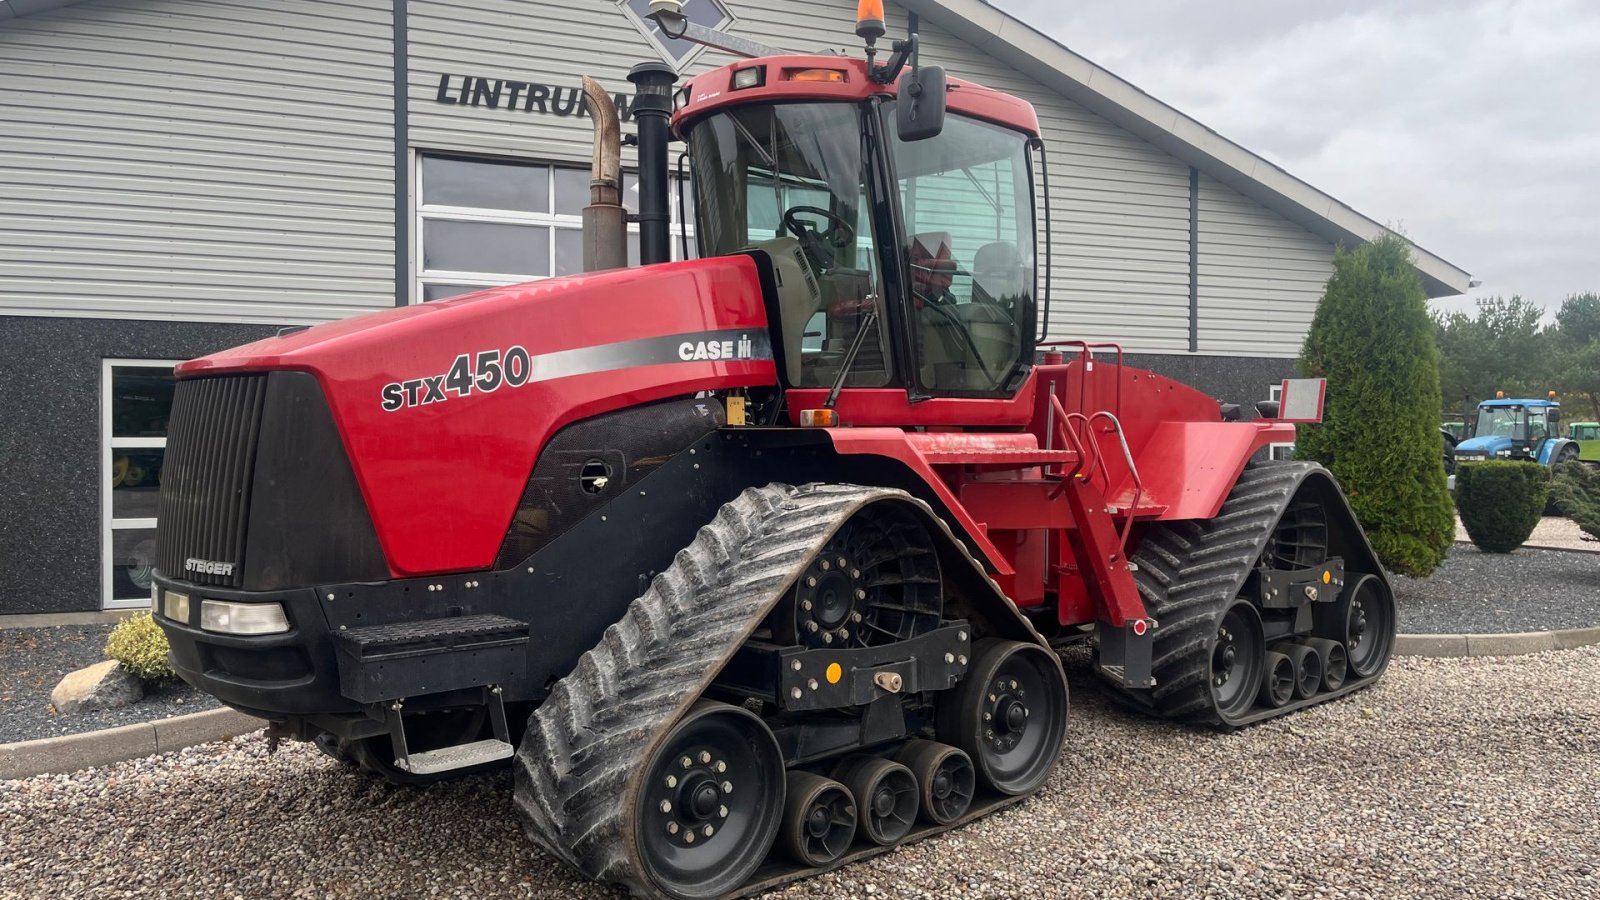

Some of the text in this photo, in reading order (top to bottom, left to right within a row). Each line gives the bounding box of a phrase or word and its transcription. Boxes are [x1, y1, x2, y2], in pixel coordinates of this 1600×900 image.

[678, 340, 733, 361] CASE
[381, 345, 531, 412] STX450
[185, 558, 233, 576] STEIGER
